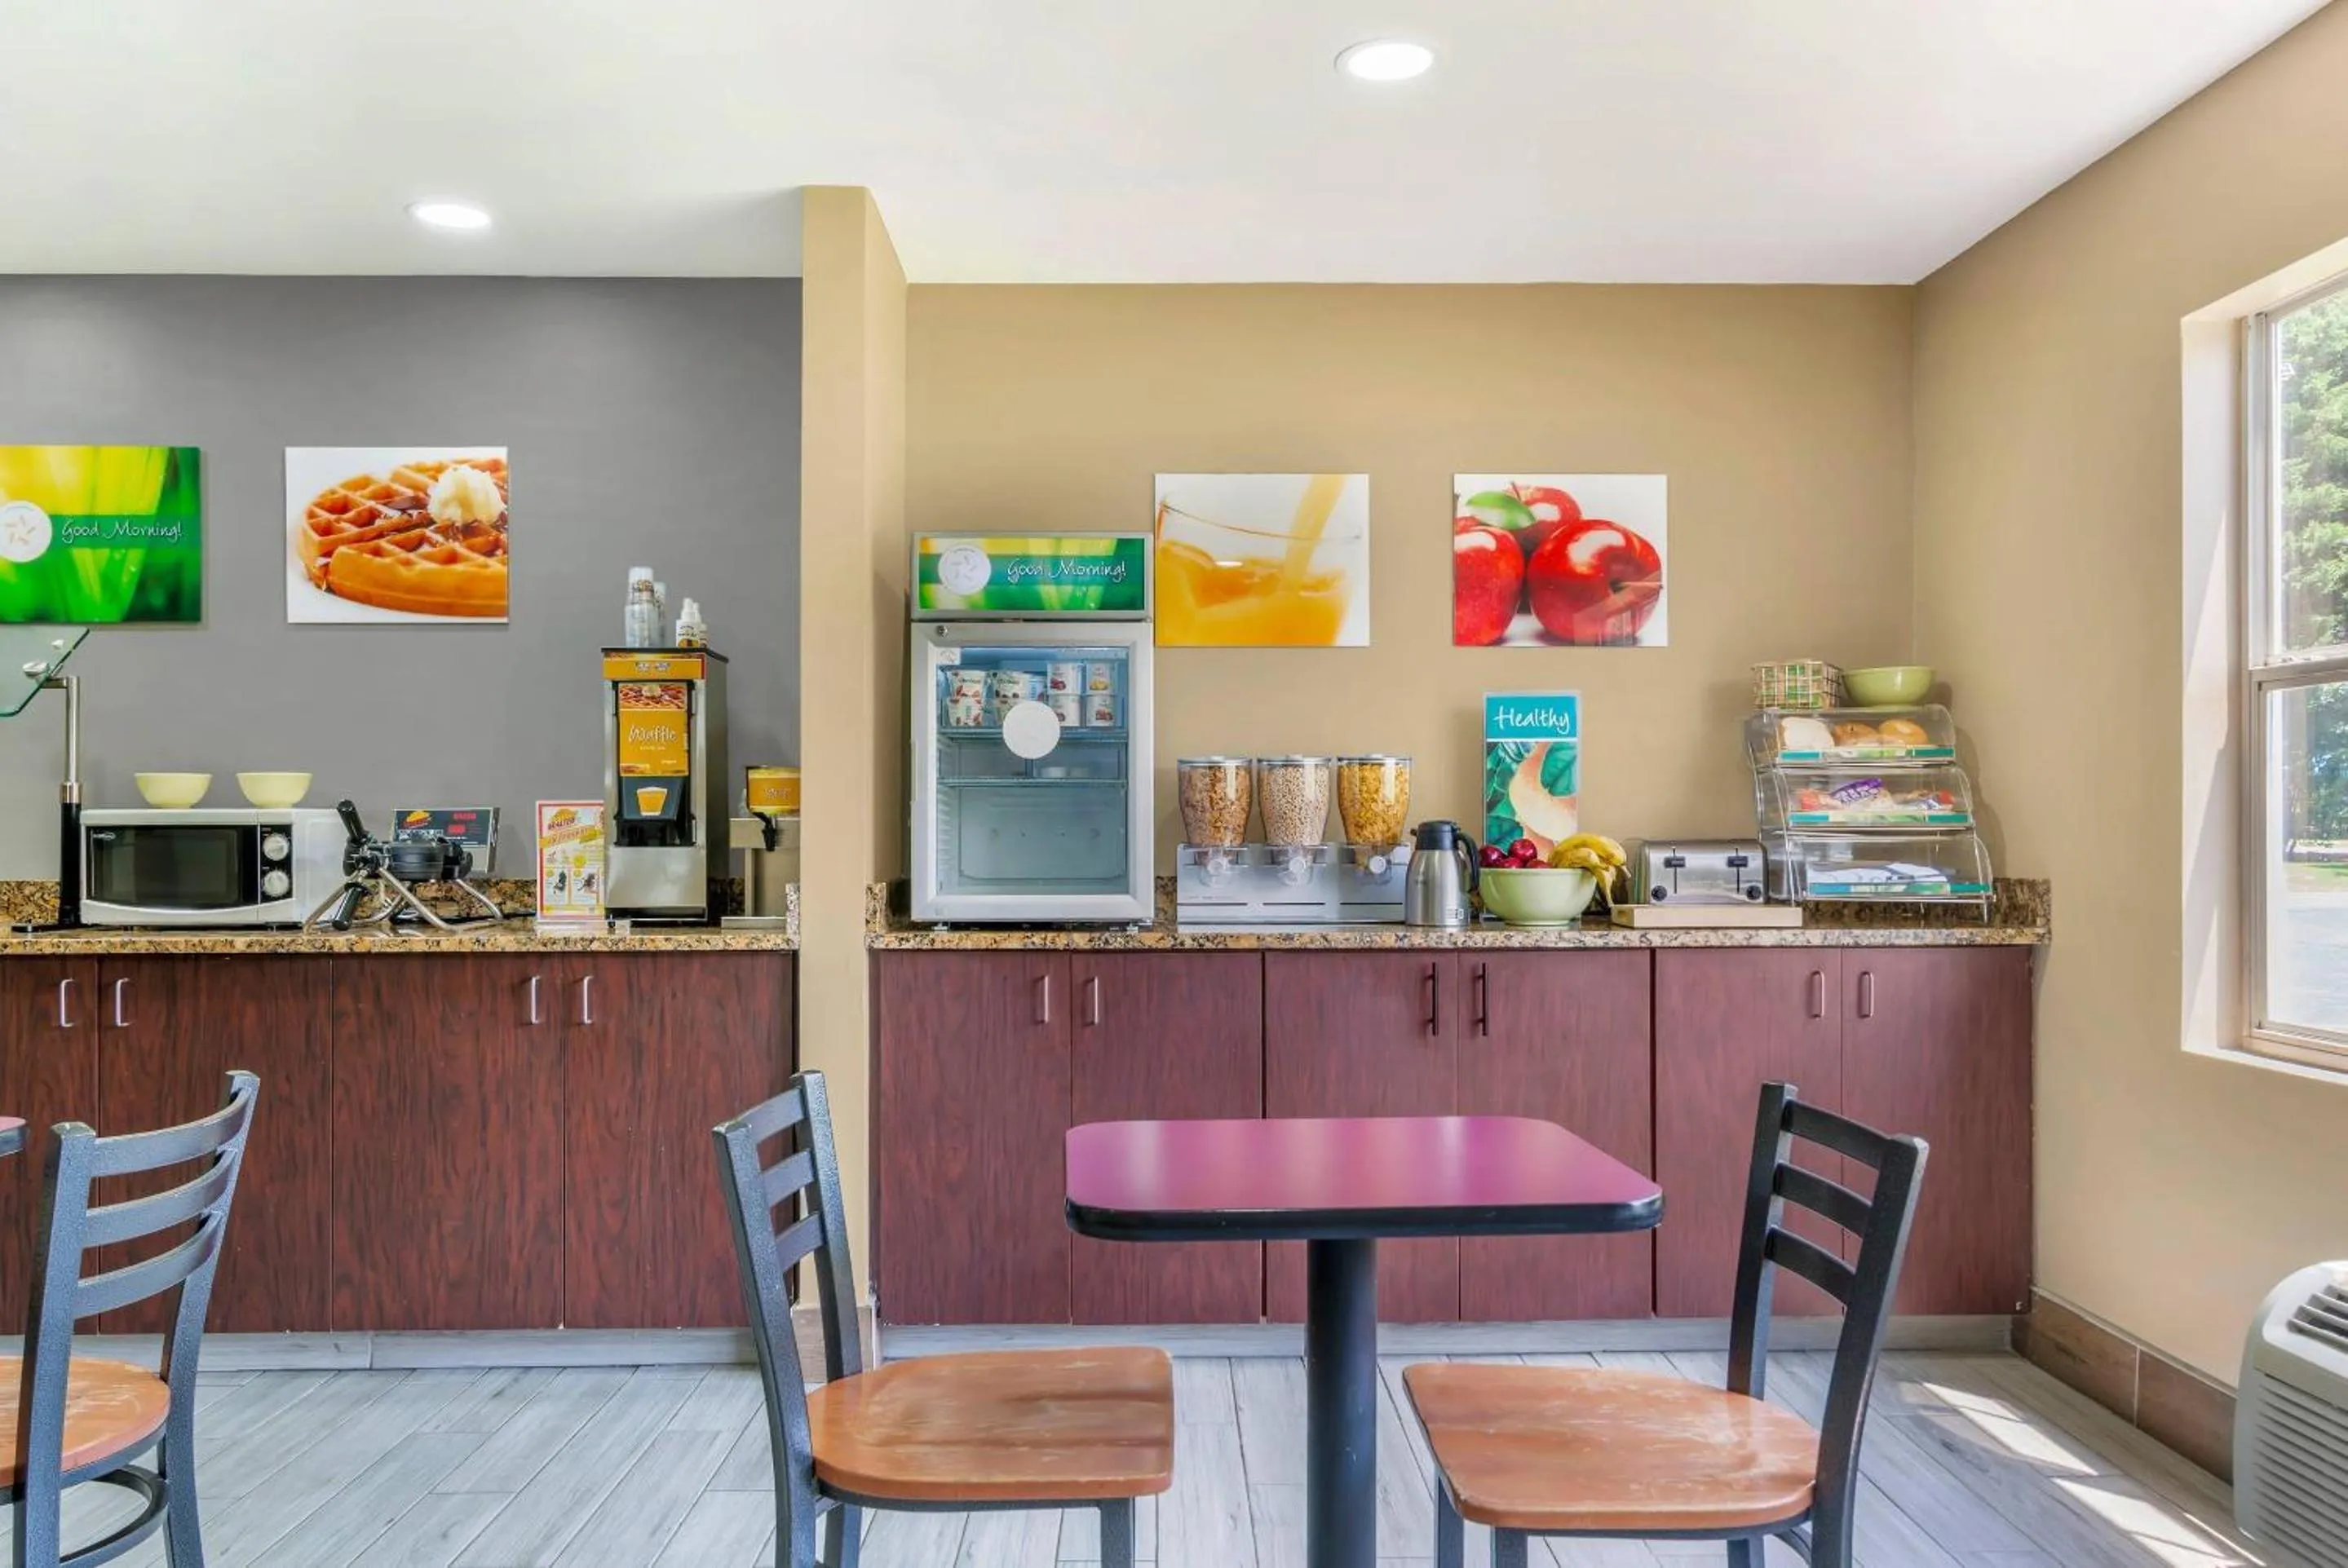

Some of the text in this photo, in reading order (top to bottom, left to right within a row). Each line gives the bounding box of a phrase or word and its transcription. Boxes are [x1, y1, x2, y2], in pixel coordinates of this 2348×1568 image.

[61, 518, 183, 544] Good Morning!
[1006, 557, 1126, 584] Good Morning!
[1492, 704, 1570, 735] Healthy
[629, 724, 676, 743] Waffle
